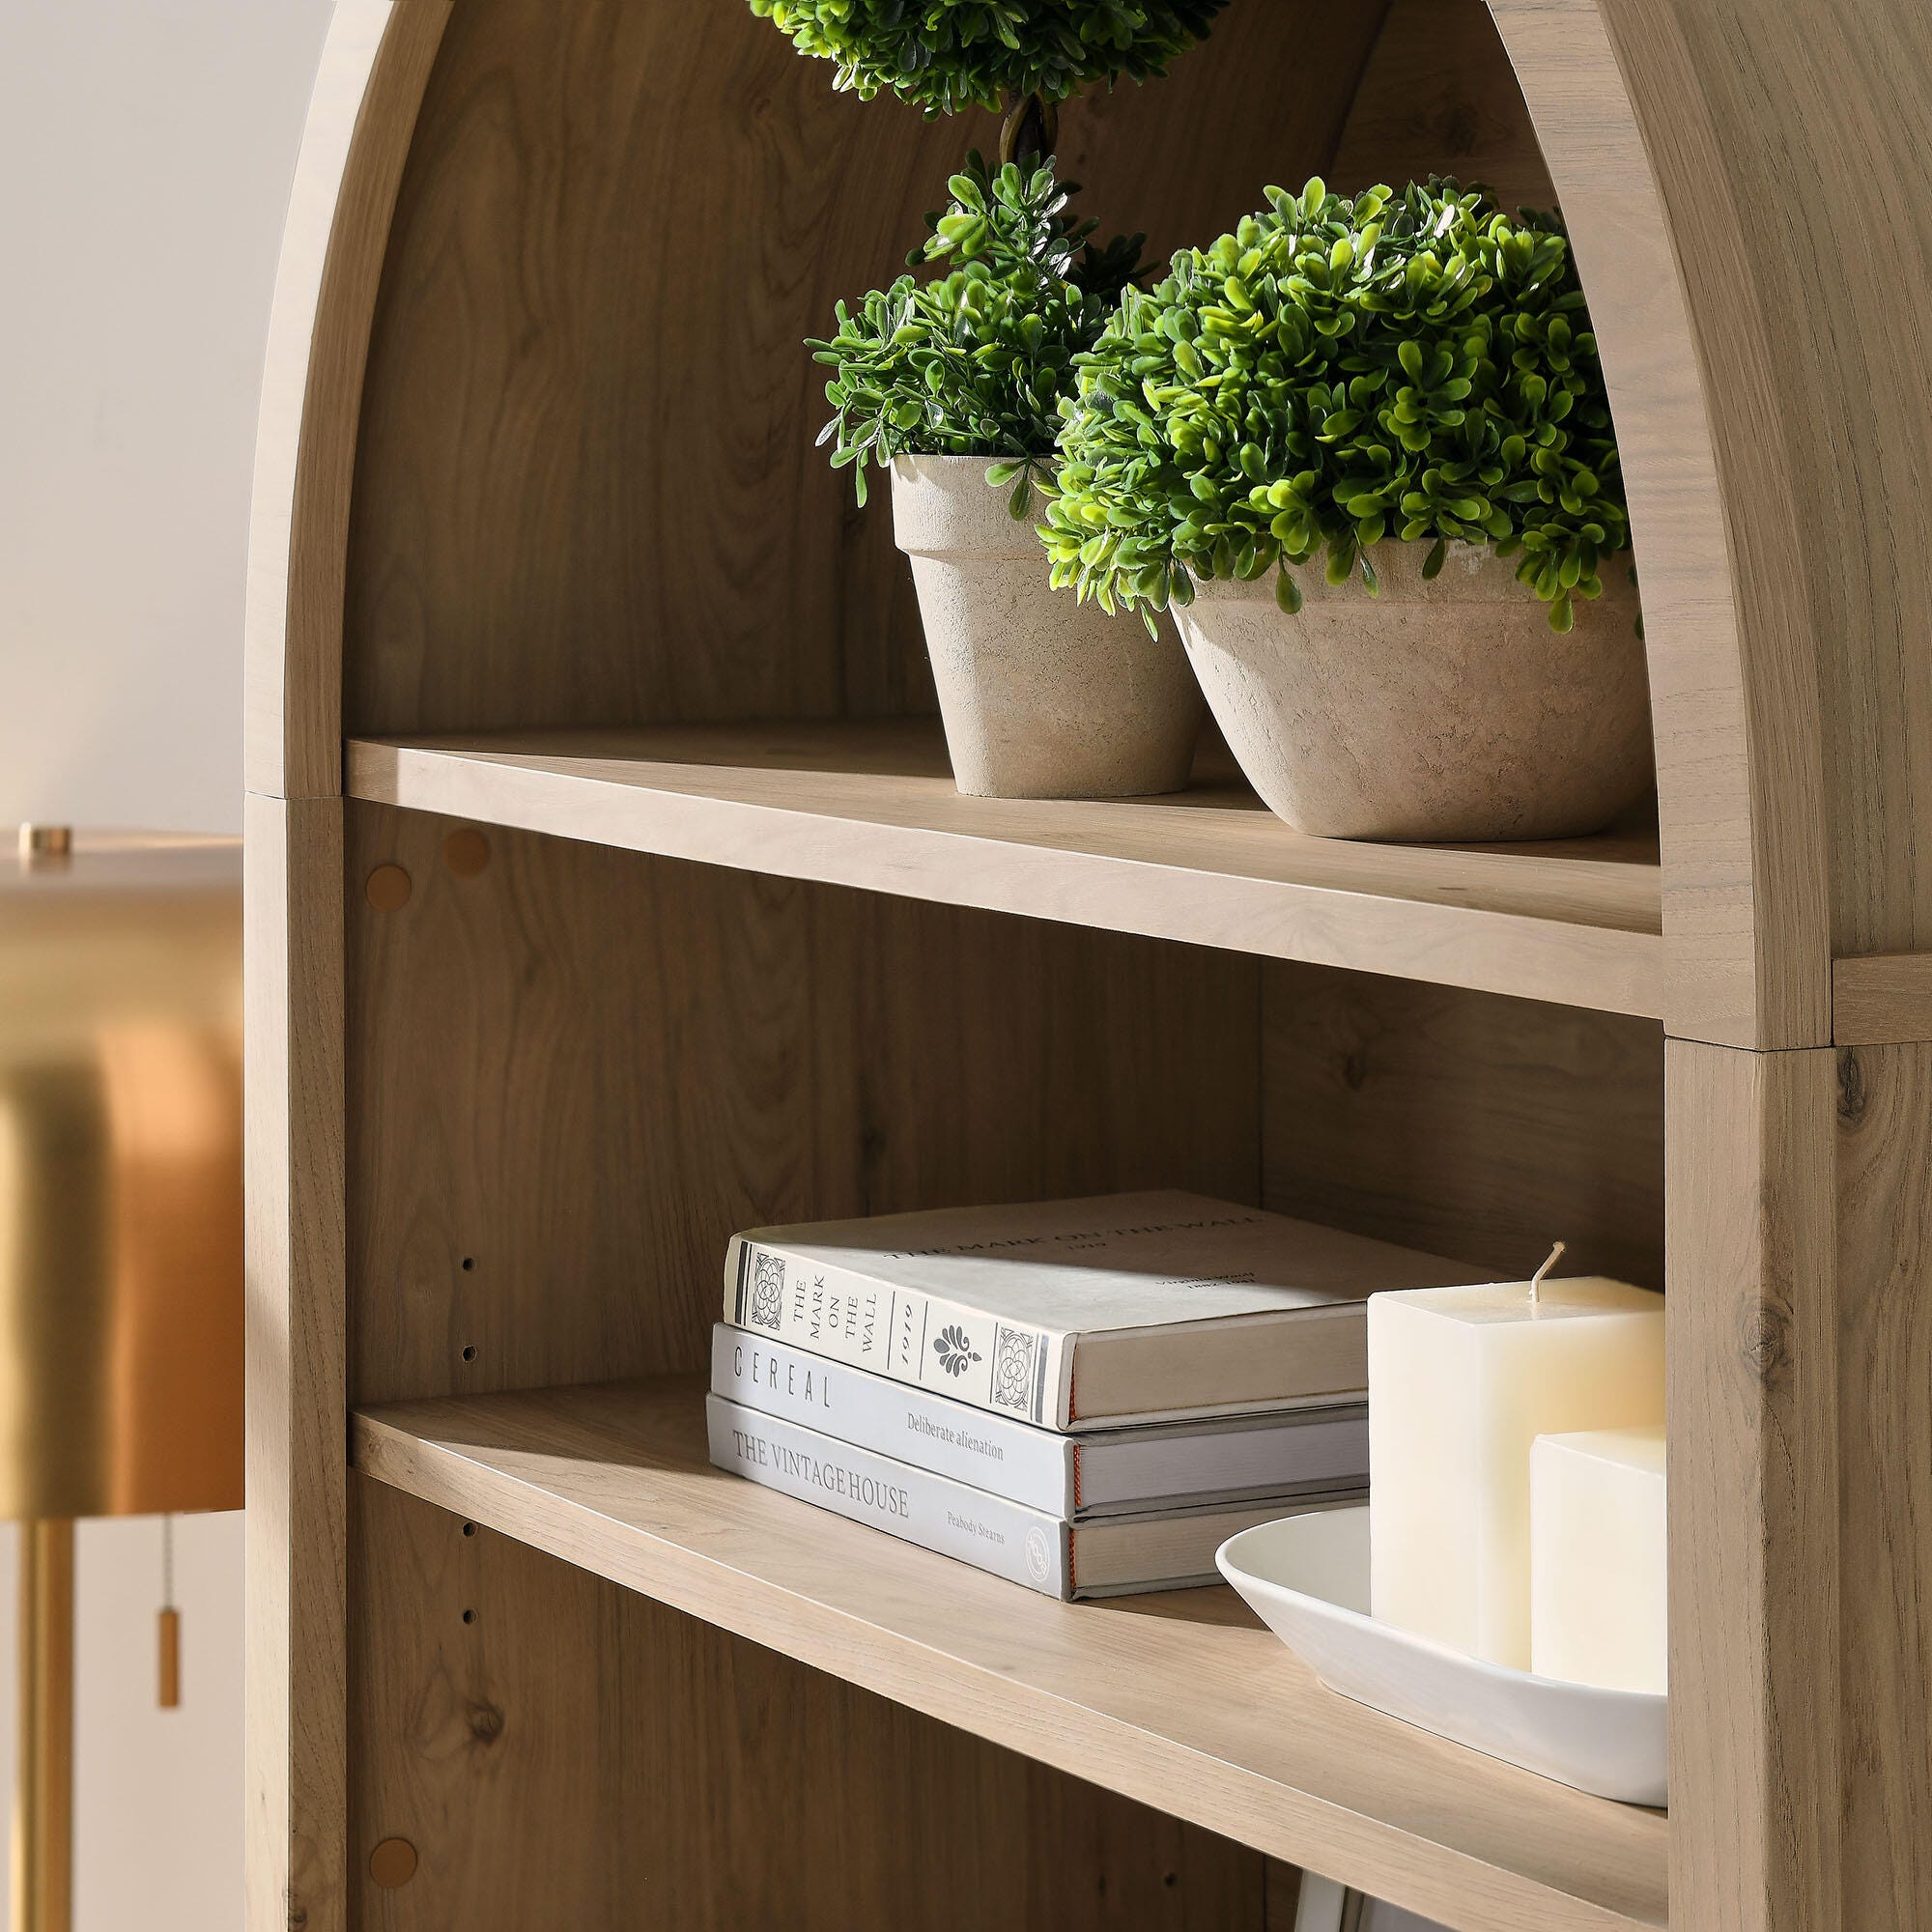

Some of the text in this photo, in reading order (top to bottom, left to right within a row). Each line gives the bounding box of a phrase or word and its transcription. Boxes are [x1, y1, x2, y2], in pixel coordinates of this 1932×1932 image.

[883, 1216, 1264, 1259] THE MARK ON THE WALL
[793, 1280, 807, 1321] THE
[810, 1275, 826, 1340] MARK
[829, 1296, 839, 1328] ON
[845, 1295, 859, 1339] THE
[862, 1293, 877, 1353] WALL
[898, 1304, 914, 1365] 1919
[734, 1346, 831, 1408] CEREAL
[906, 1412, 1004, 1462] Deliberate alienation
[732, 1429, 909, 1518] THE VINTAGE HOUSE
[948, 1512, 1005, 1546] Peabody Stearns
